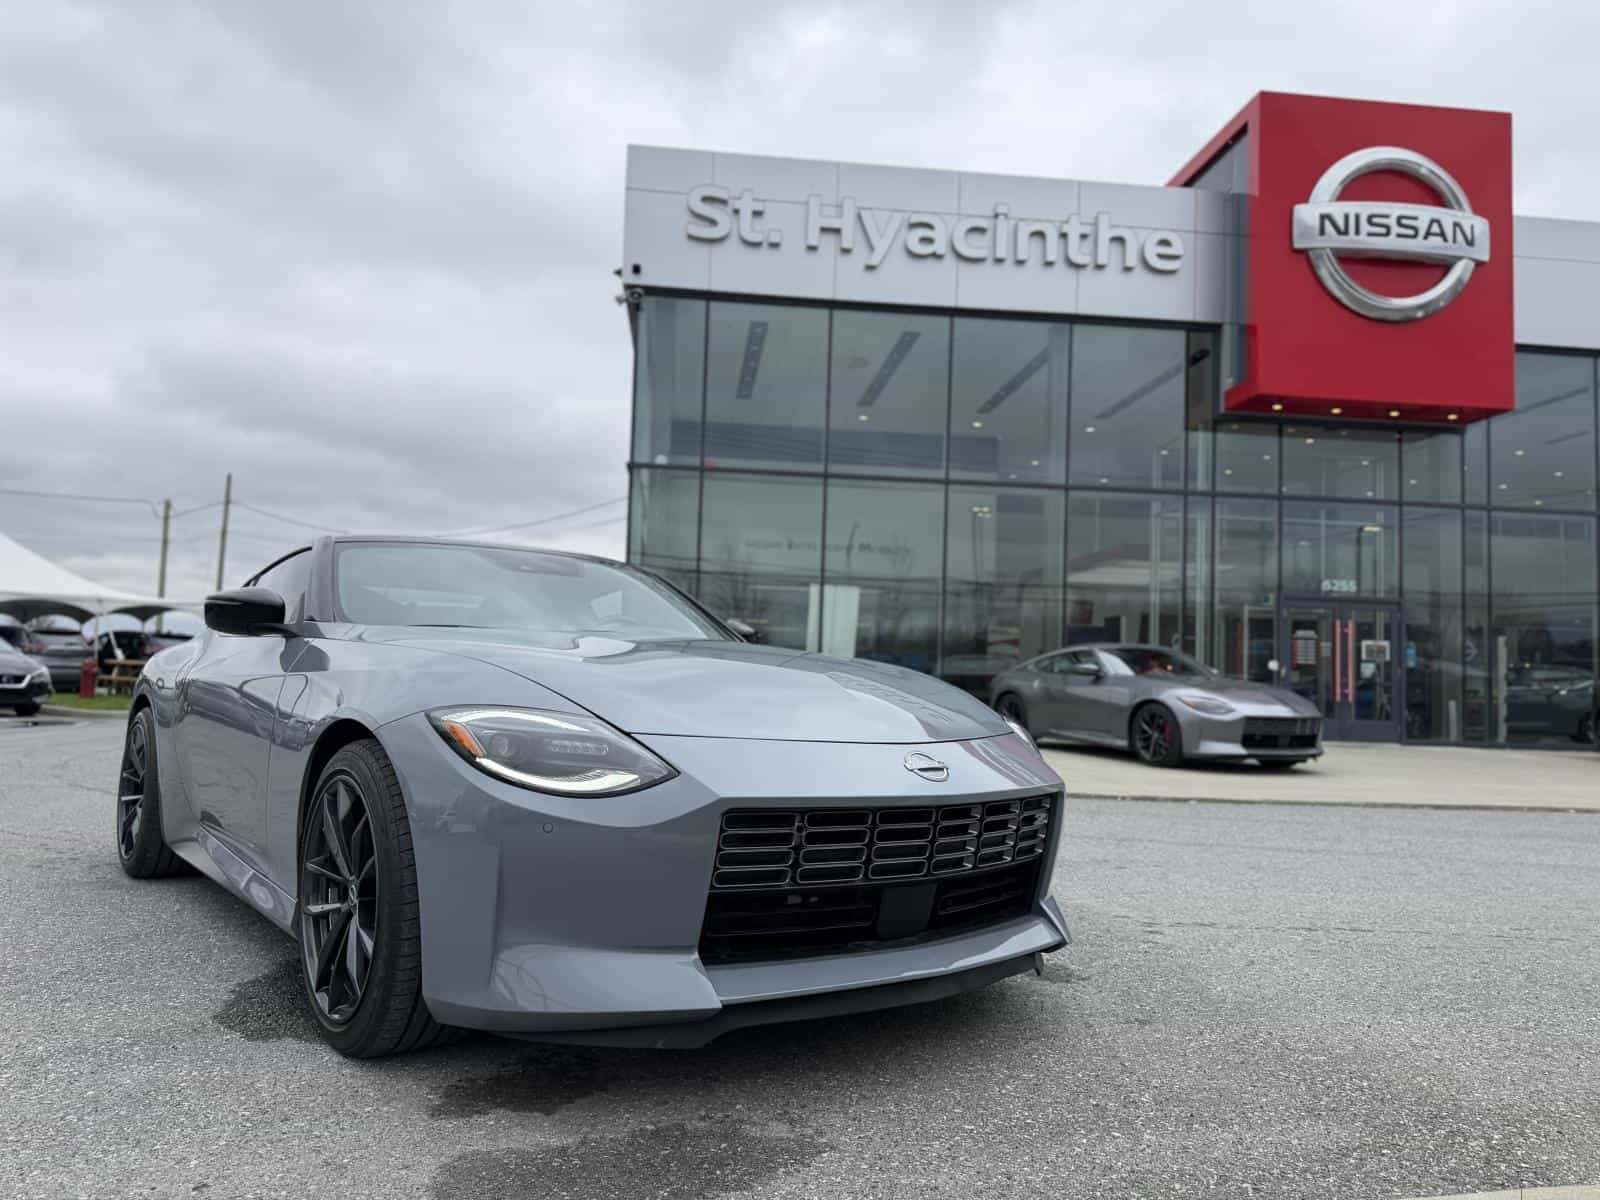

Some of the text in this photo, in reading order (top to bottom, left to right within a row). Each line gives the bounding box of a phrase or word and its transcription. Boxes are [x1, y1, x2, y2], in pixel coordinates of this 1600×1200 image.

[686, 184, 1184, 274] St. Hyacinthe
[1318, 212, 1475, 248] NISSAN
